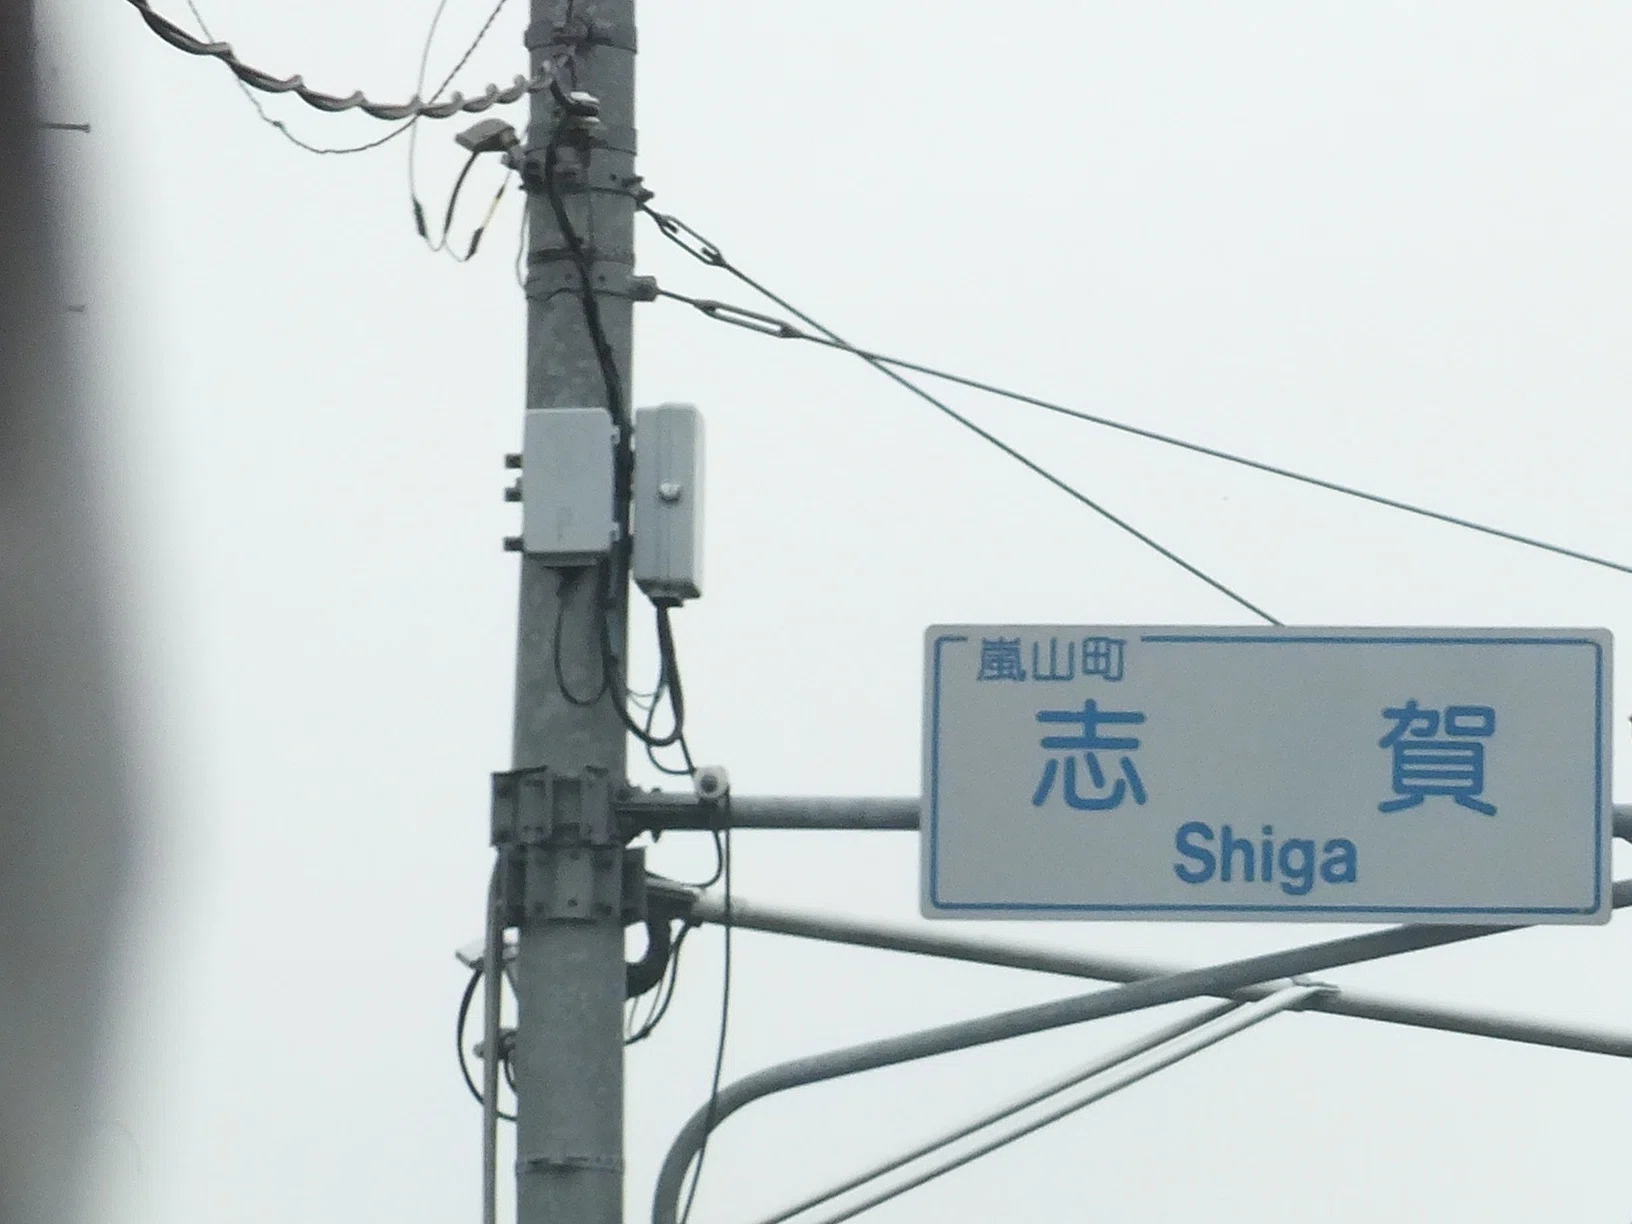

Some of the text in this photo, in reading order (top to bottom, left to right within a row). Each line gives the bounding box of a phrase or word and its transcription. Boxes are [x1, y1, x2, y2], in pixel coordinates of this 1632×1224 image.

[977, 636, 1127, 682] 嵐山町
[1032, 698, 1498, 817] 志賀
[1173, 820, 1359, 897] Shiga
